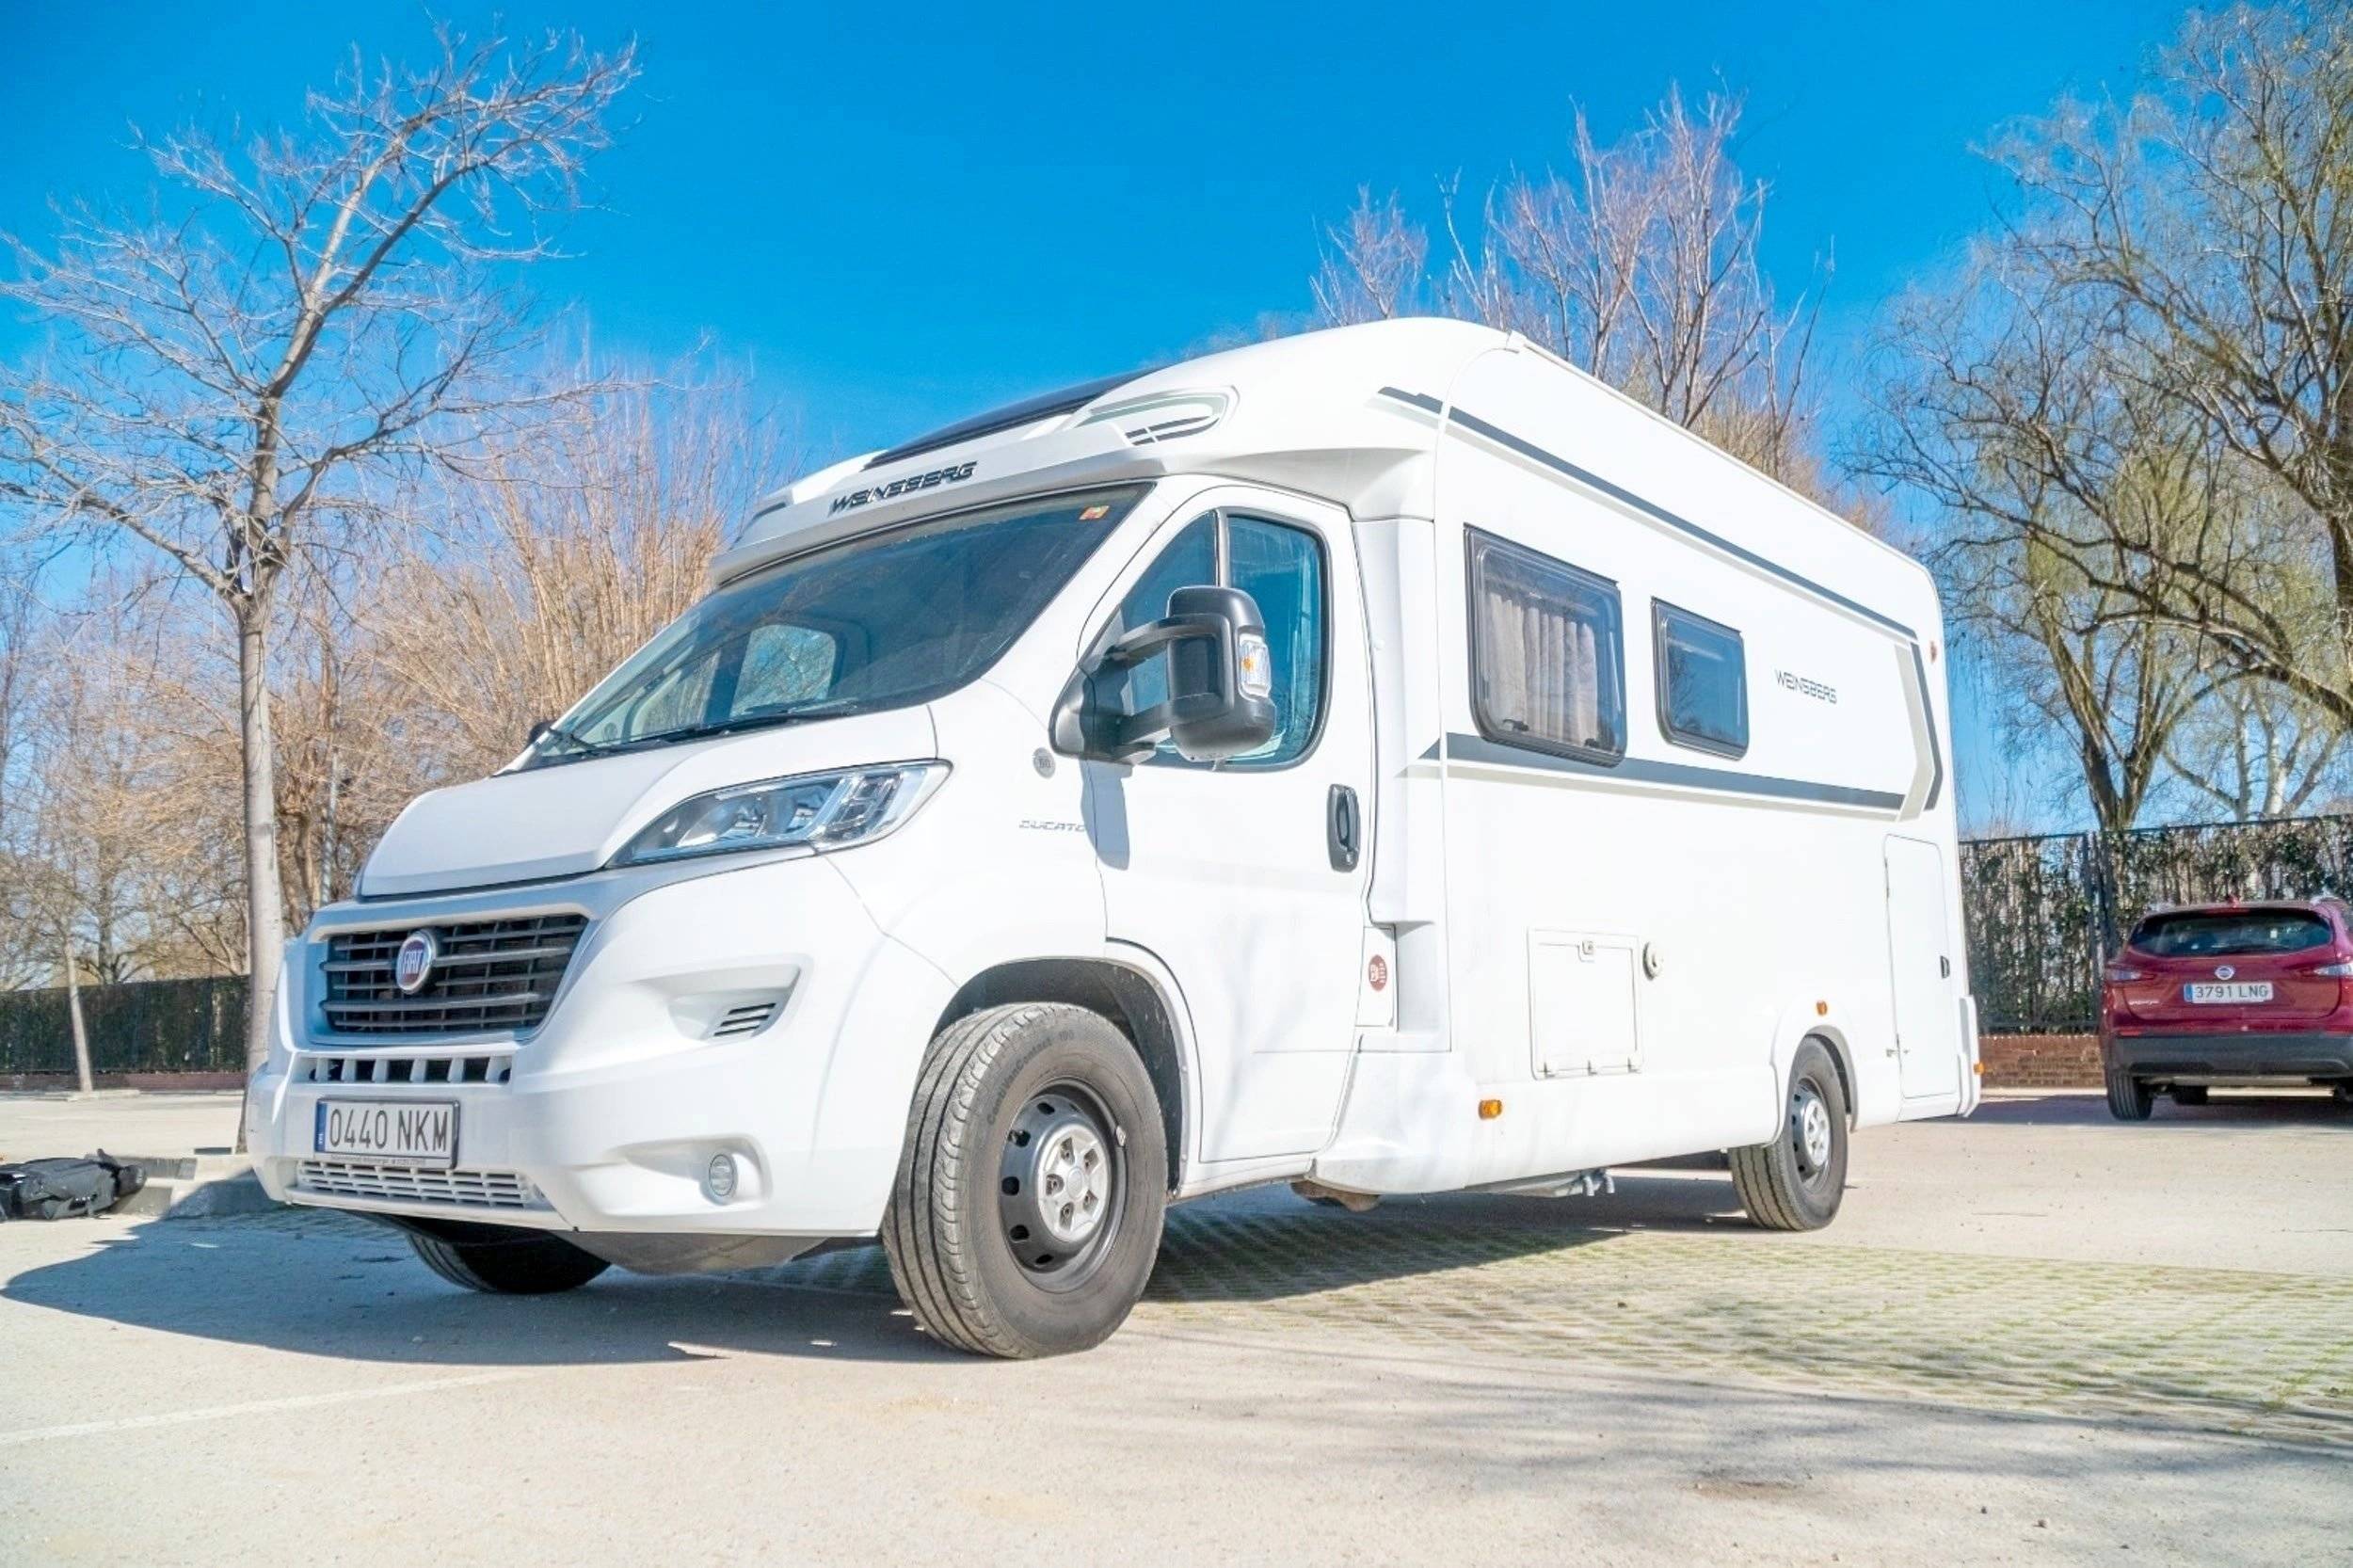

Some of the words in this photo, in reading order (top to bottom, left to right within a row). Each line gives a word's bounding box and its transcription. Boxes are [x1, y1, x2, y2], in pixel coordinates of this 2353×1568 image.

[828, 461, 977, 515] WEINSBERG
[1774, 668, 1837, 704] WEINSBERG
[1018, 820, 1086, 832] DUCATO
[402, 949, 424, 974] FIAT
[2196, 985, 2233, 999] 3791
[2238, 984, 2268, 999] LNG
[329, 1109, 388, 1149] 0440
[397, 1110, 448, 1151] NKM
